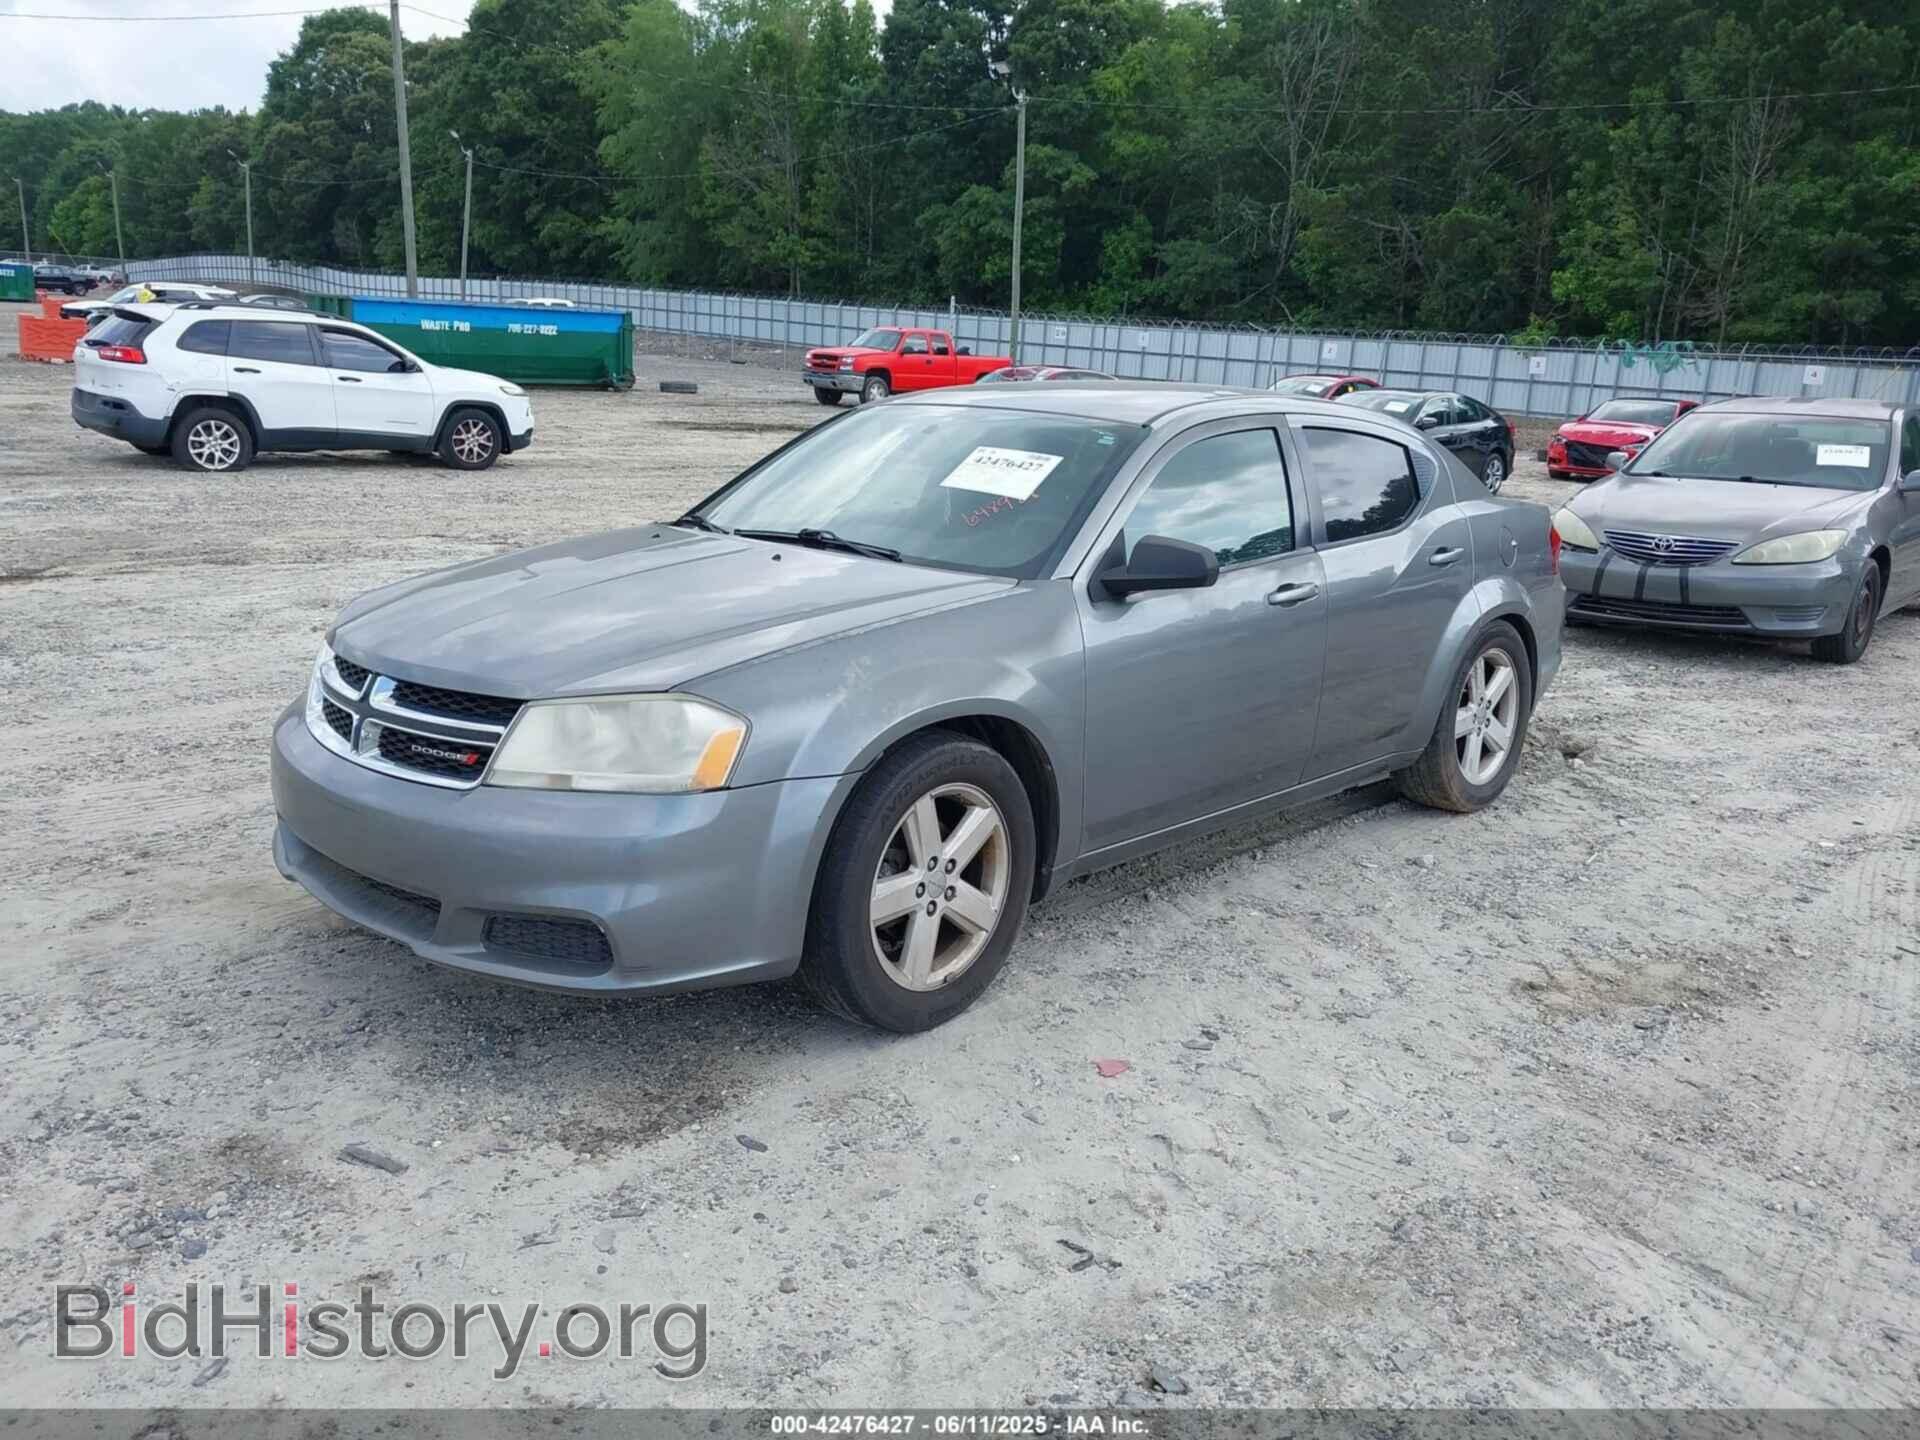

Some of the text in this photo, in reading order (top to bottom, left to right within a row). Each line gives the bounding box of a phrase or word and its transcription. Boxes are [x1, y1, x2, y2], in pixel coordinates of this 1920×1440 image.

[421, 319, 470, 332] WASTE PRO
[973, 454, 1044, 469] 42476427
[411, 744, 466, 762] DODGE
